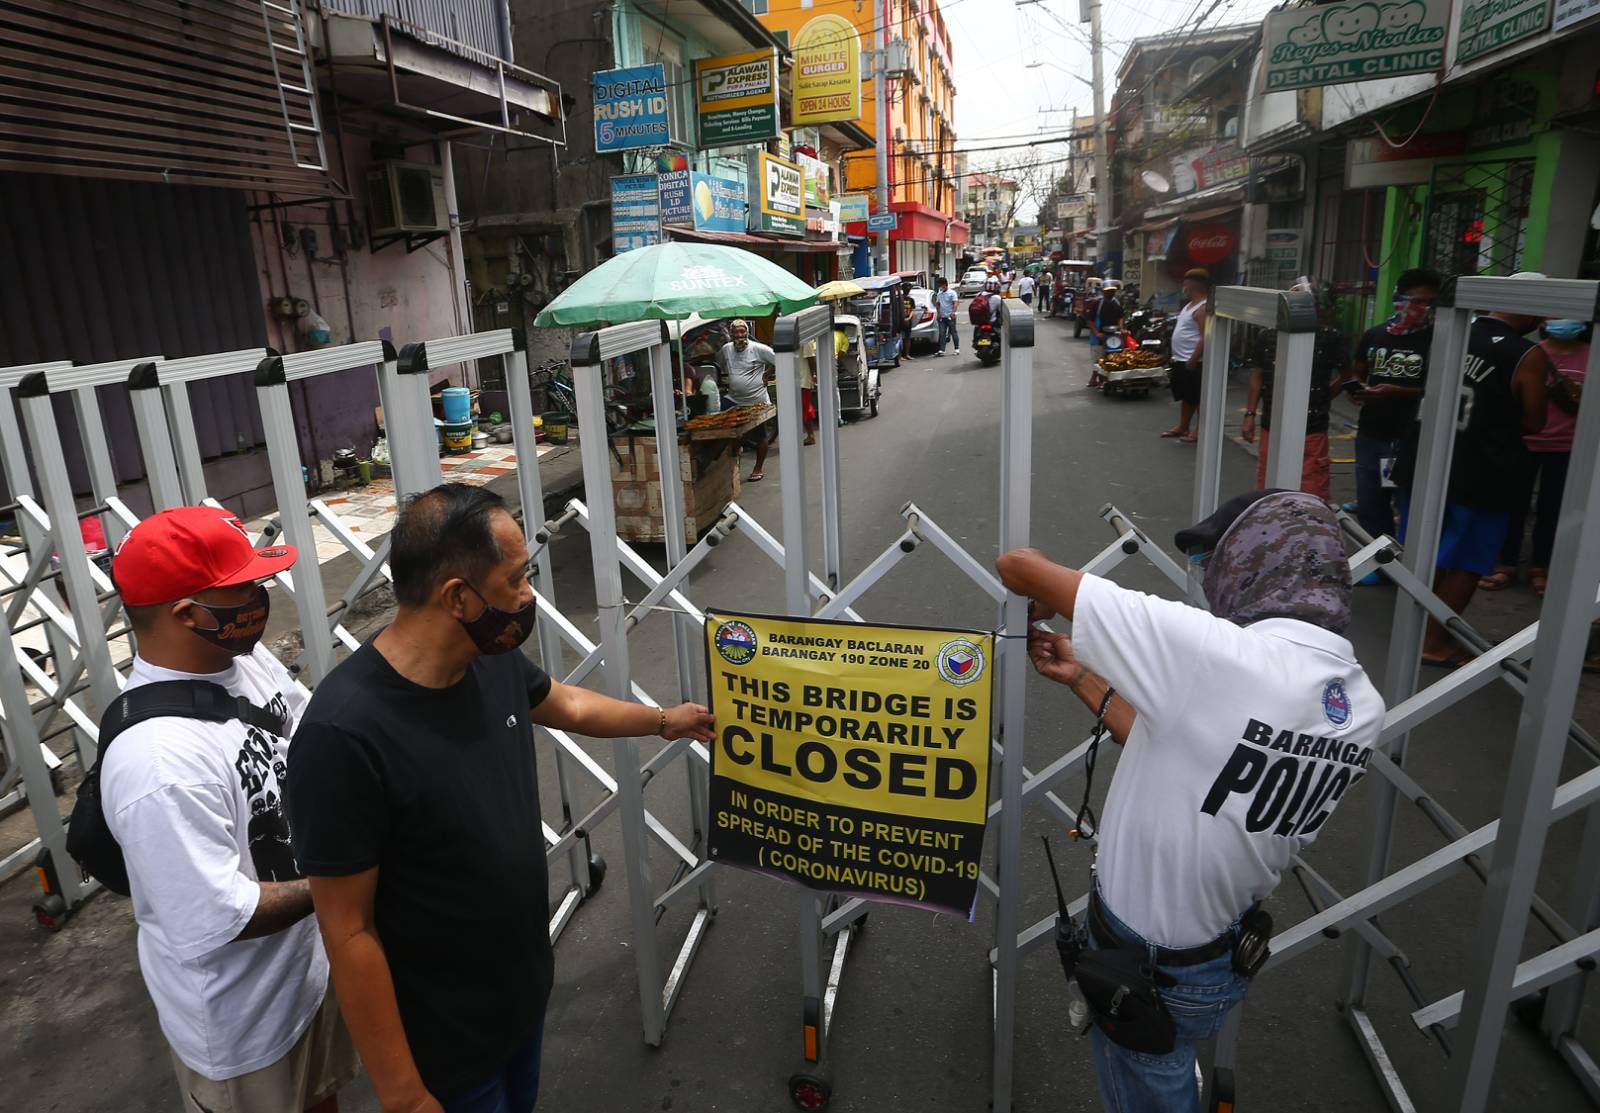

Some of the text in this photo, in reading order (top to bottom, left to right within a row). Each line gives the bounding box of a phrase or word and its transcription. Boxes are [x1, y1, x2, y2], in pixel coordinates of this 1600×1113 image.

[1270, 24, 1445, 64] Reyes-Nicolas
[1459, 28, 1498, 58] DENTAL
[1502, 8, 1544, 40] CLINIC
[801, 51, 847, 64] MINUTE
[803, 62, 845, 74] BURGER
[1269, 51, 1442, 87] DENTAL CLINIC
[596, 78, 665, 99] DIGITAL
[727, 72, 768, 85] EXPRESS
[594, 97, 666, 120] RUSH ID
[800, 96, 850, 113] OPEN 24 HOURS
[615, 122, 667, 137] MINUTES
[657, 170, 689, 182] KONICA
[659, 179, 689, 191] DIGITAL
[664, 190, 684, 199] RUSH
[669, 275, 748, 291] SUNTEX
[769, 633, 924, 655] BARANGAY BACLARAN
[762, 646, 930, 670] BARANGAY 190 ZONE 20
[722, 671, 977, 720] THIS BRIDGE IS
[732, 698, 966, 750] TEMPORARILY
[1242, 718, 1374, 769] BARANGA
[722, 725, 977, 800] CLOSED
[1200, 743, 1367, 837] POLIC
[731, 790, 964, 851] IN ORDER TO PREVENT
[717, 811, 978, 881] SPREAD OF THE COVID-19
